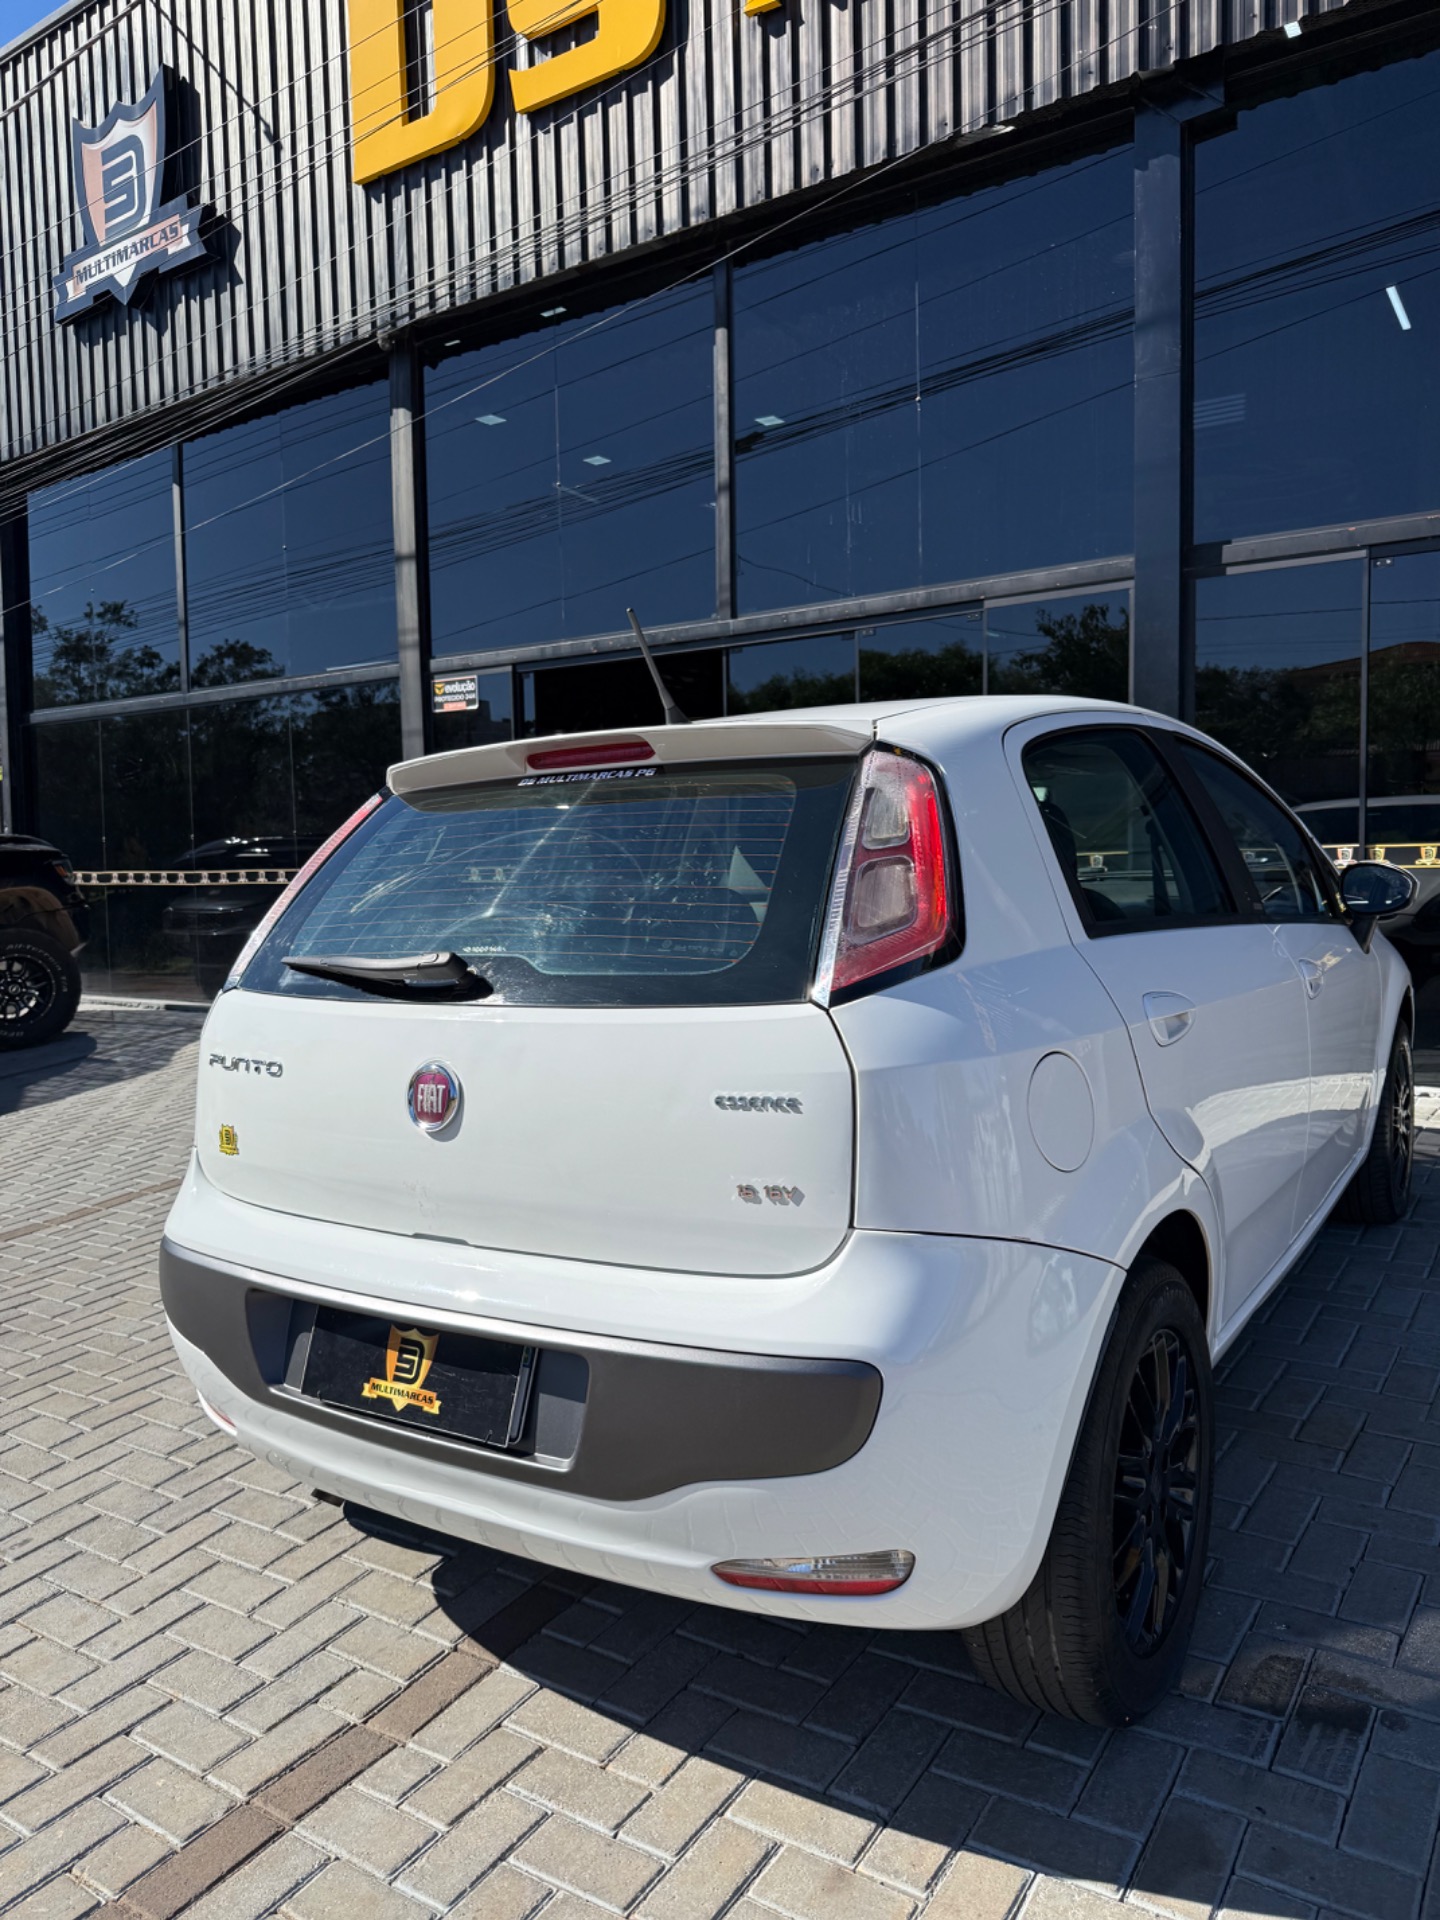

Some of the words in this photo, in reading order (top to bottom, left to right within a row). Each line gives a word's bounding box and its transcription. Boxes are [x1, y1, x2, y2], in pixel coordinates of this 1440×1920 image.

[75, 223, 179, 285] MULTIMARCAS
[444, 680, 476, 693] evolução
[536, 769, 634, 784] MULTIMARCAS
[635, 767, 658, 777] PG
[209, 1053, 283, 1078] PUNTO
[417, 1083, 446, 1114] FIAT
[371, 1382, 434, 1405] MULTIMARCAS
